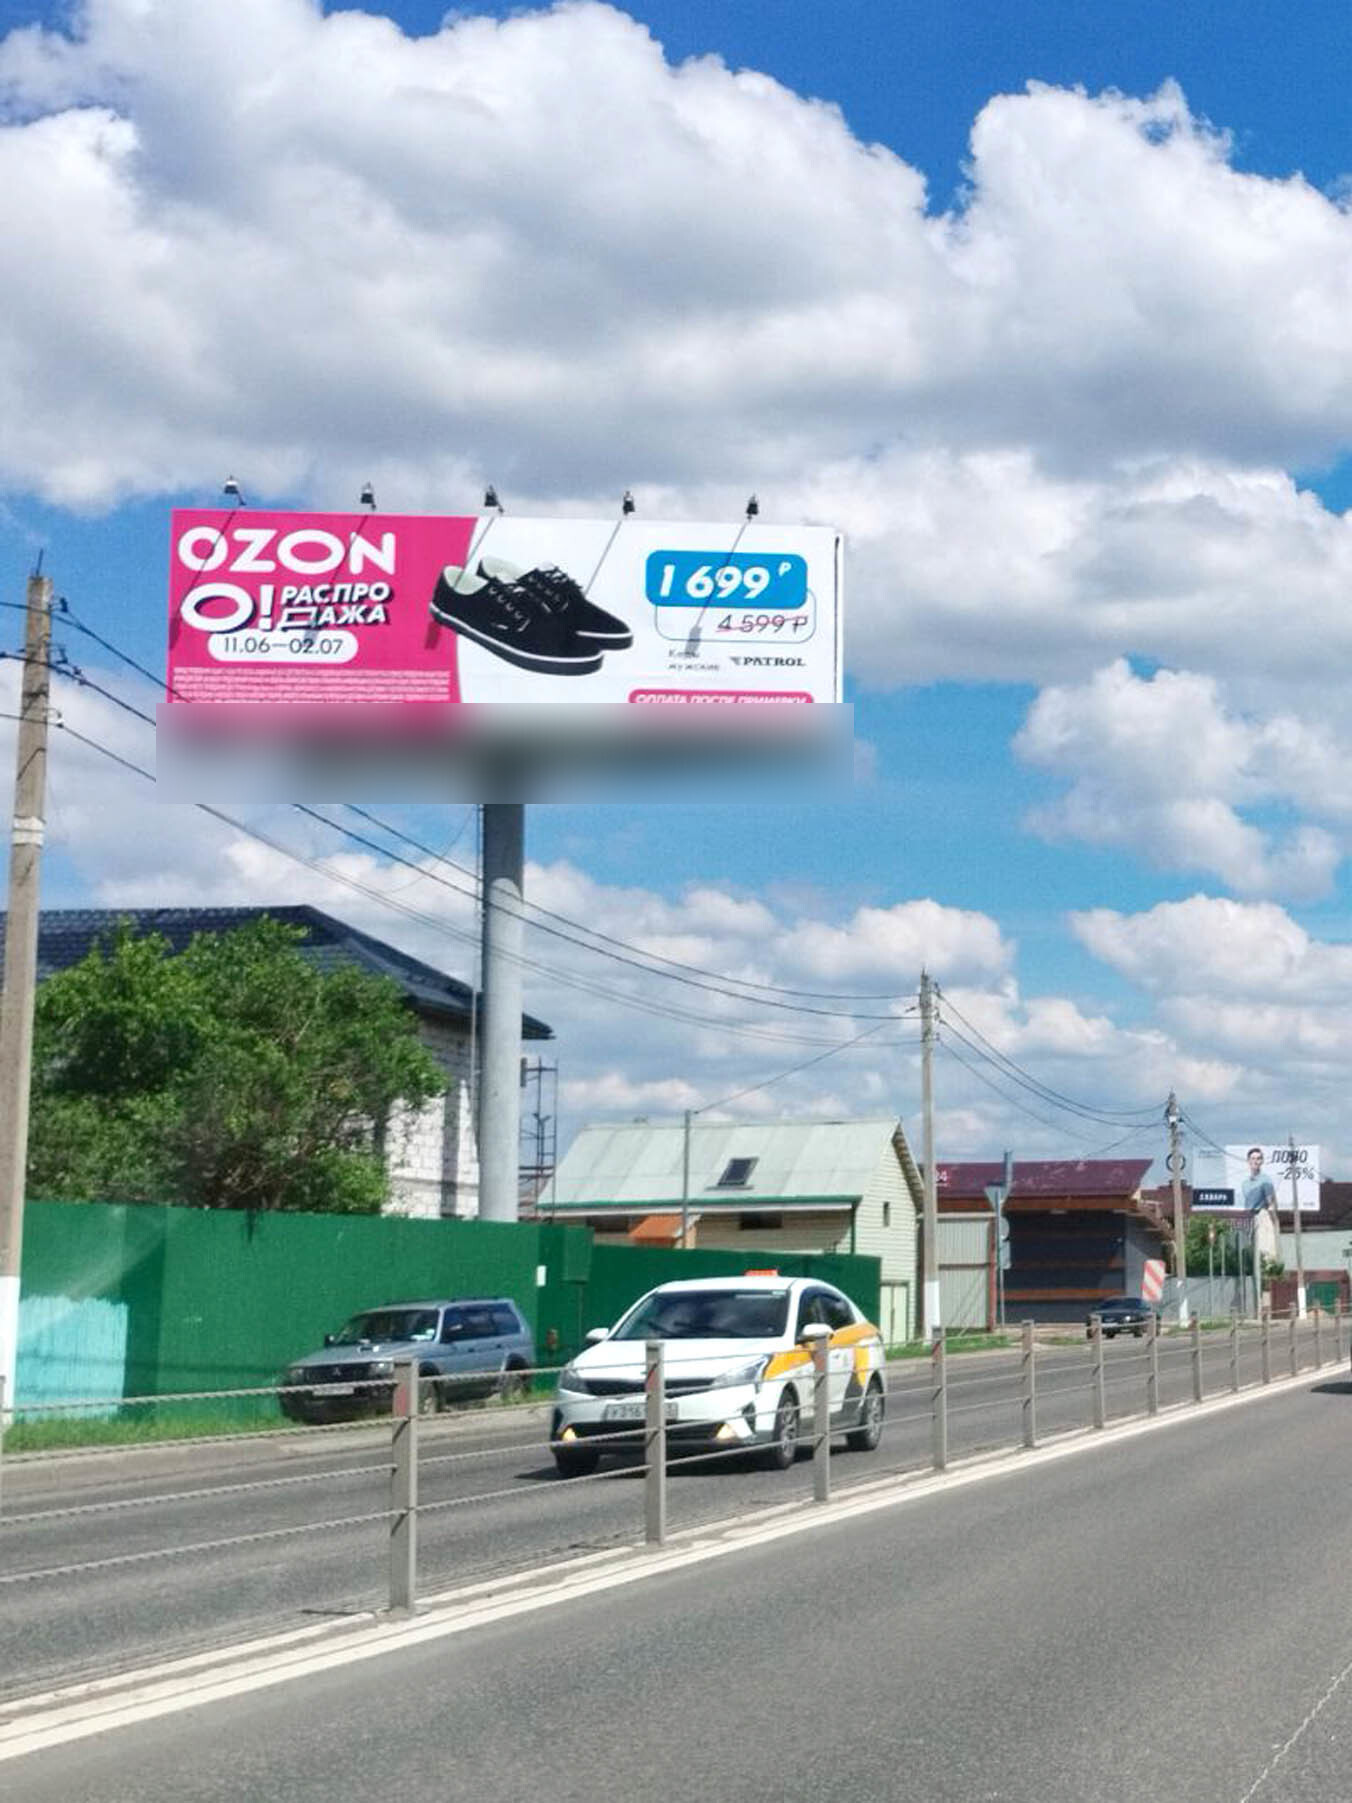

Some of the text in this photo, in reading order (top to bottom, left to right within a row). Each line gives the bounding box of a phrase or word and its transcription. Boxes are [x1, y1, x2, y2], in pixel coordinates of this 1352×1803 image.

[178, 526, 396, 575] OZON
[281, 582, 391, 605] РАСПРО
[686, 565, 771, 599] 699
[743, 656, 806, 668] PATROL
